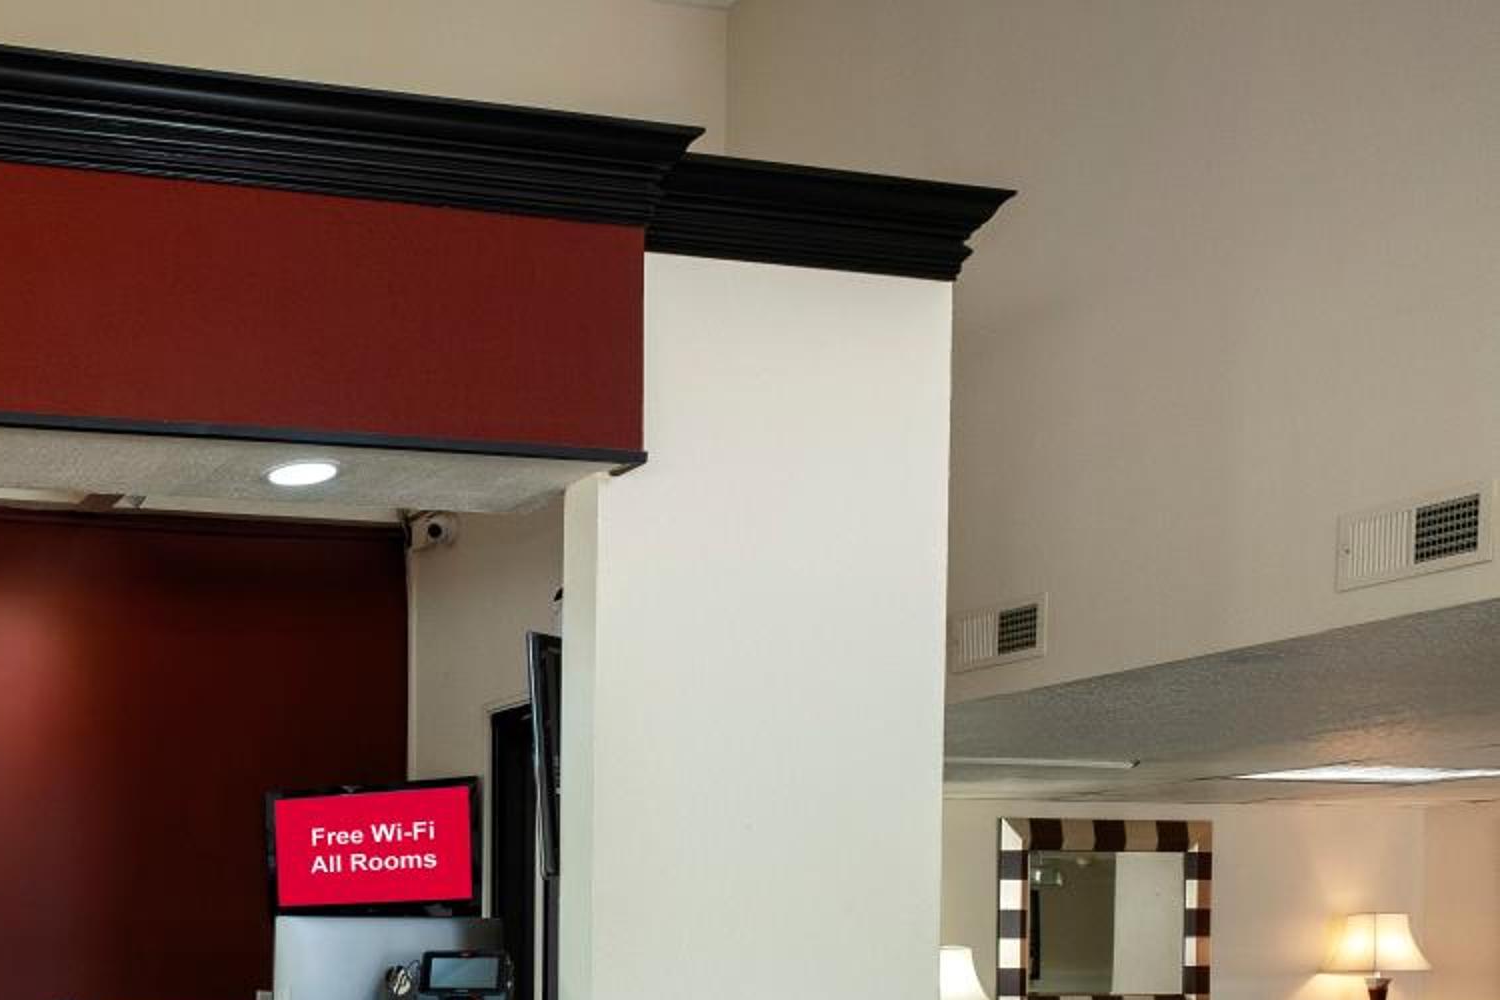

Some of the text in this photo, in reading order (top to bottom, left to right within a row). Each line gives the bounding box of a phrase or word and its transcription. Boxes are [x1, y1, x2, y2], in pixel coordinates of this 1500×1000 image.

[310, 820, 435, 847] Free Wi-Fi
[311, 853, 437, 874] All Rooms
